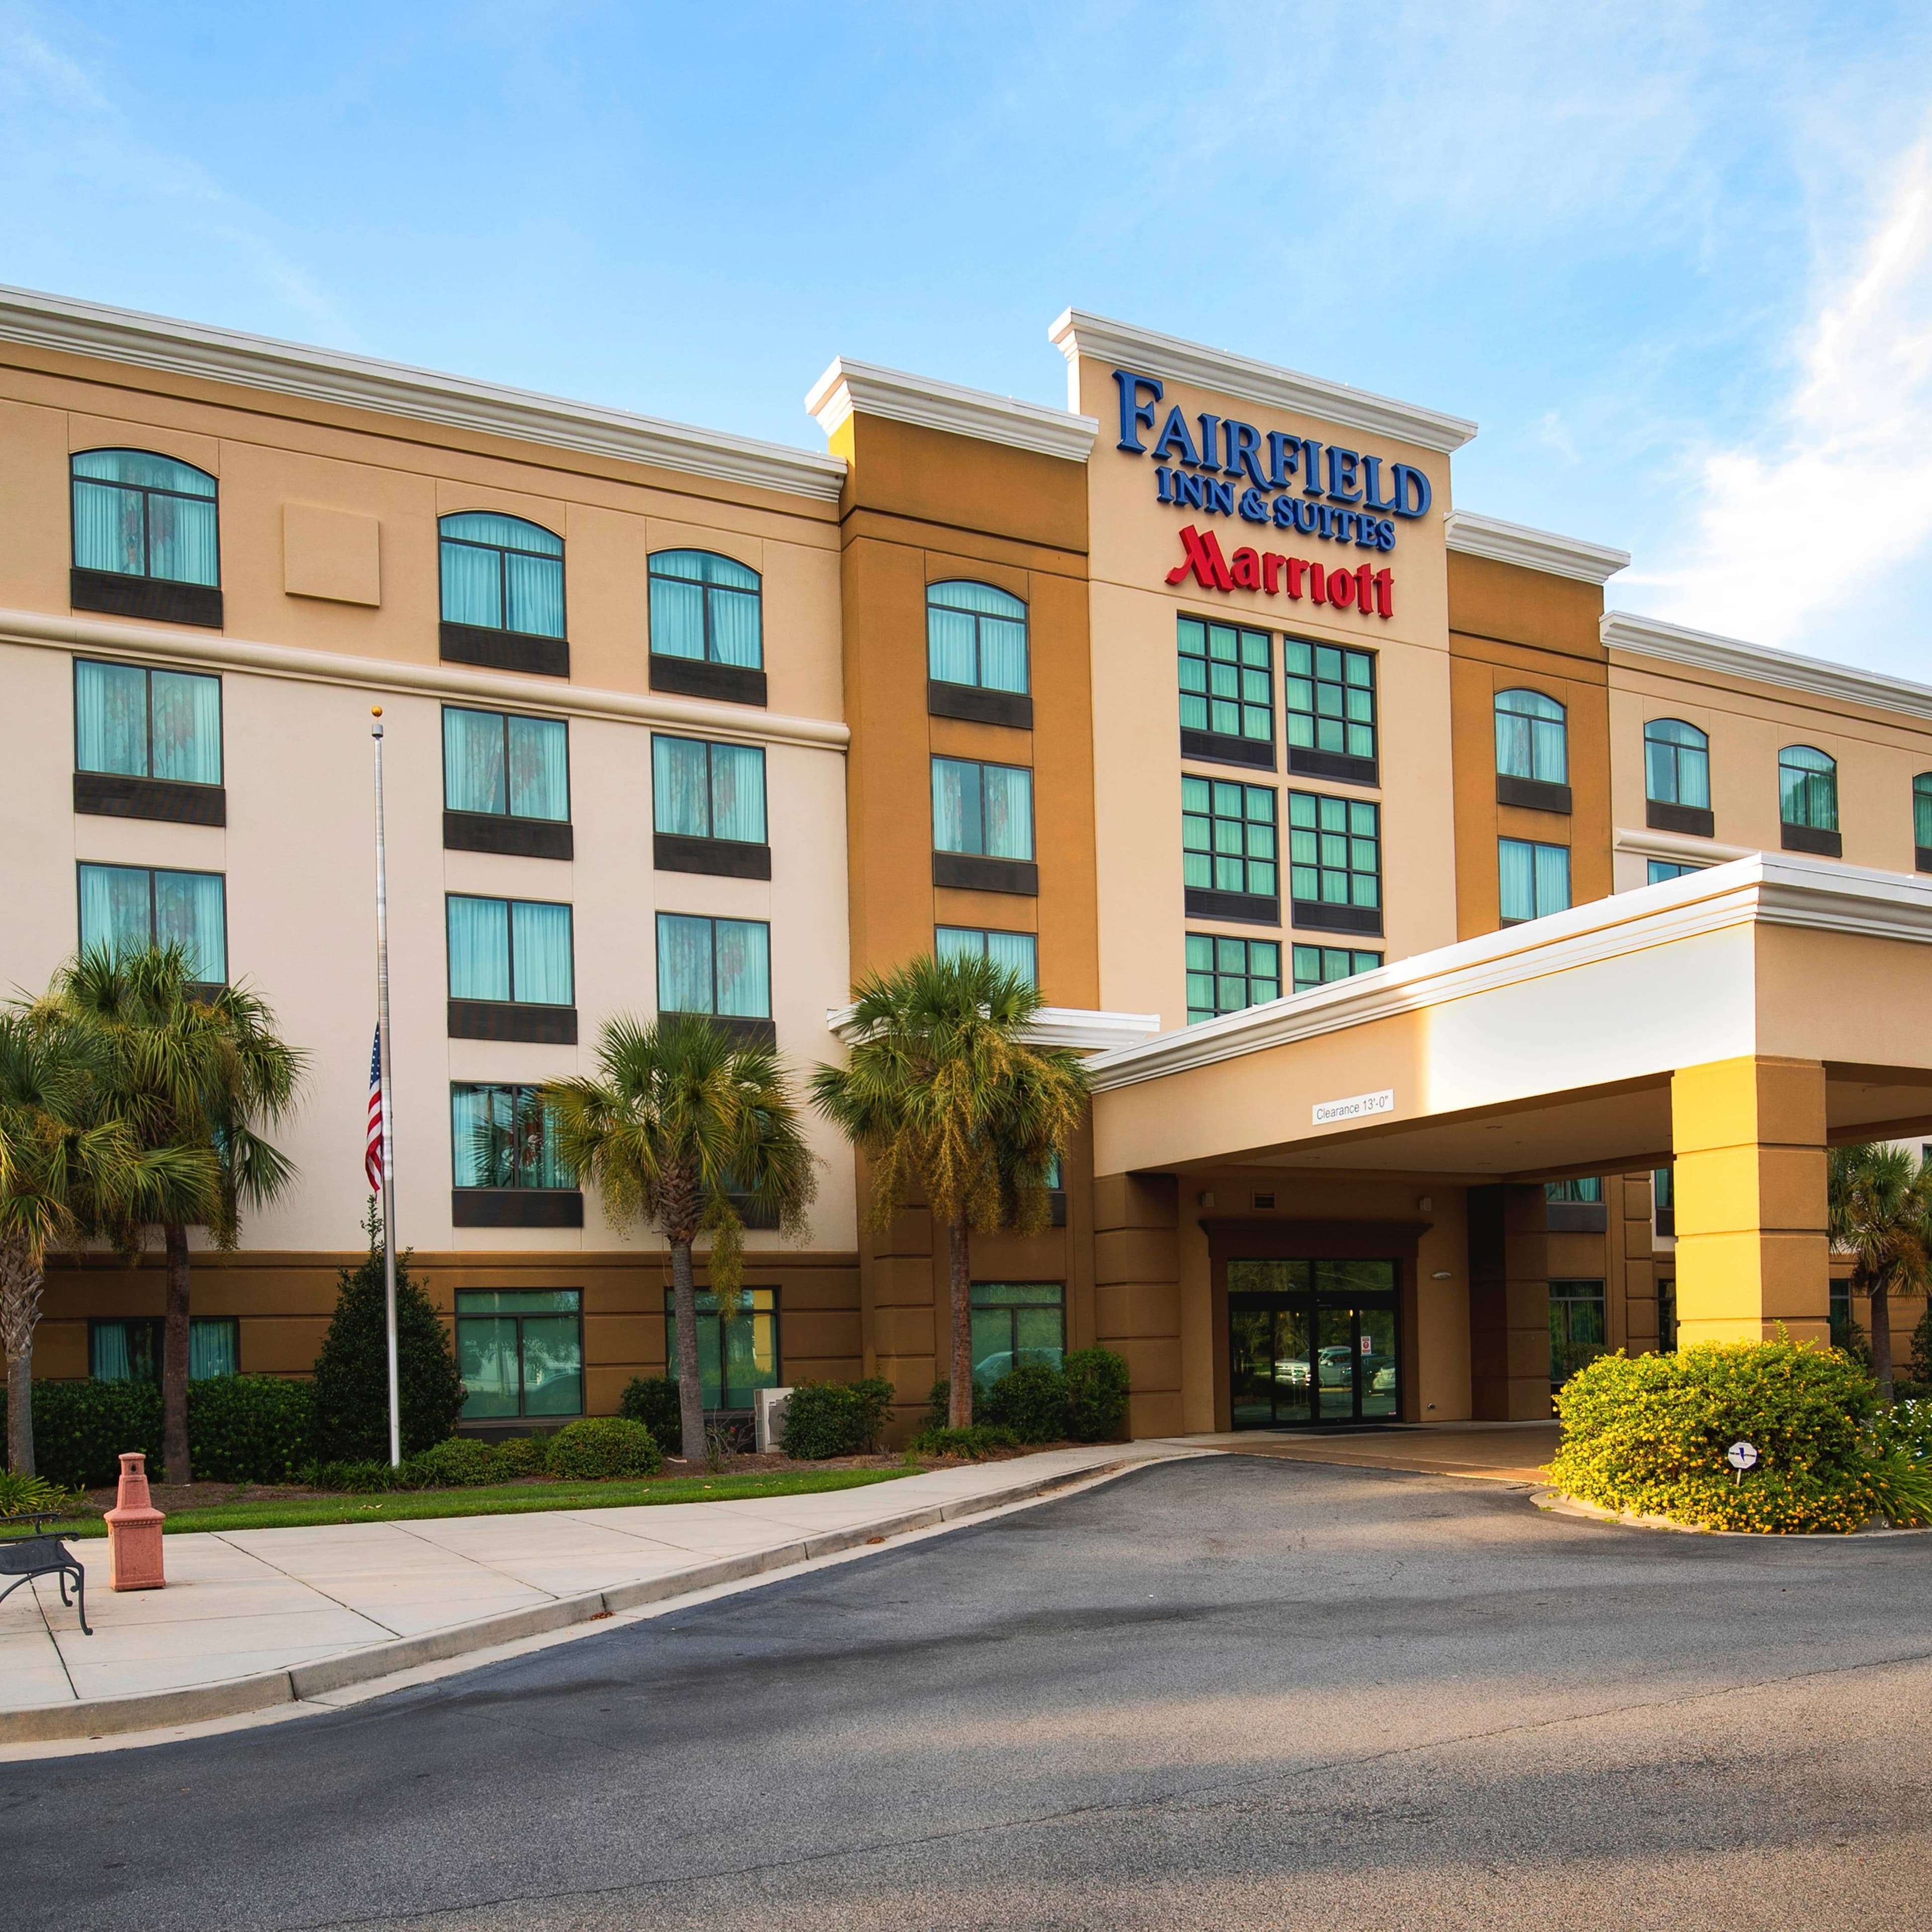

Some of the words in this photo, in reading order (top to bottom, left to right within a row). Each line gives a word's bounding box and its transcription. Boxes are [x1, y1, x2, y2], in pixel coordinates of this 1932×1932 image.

[1112, 369, 1432, 519] FAIRFIELD
[1155, 466, 1236, 517] INN
[1239, 487, 1271, 524] &
[1273, 495, 1395, 552] SUITES
[1164, 525, 1394, 619] Marriott
[1316, 1104, 1359, 1120] Clearance
